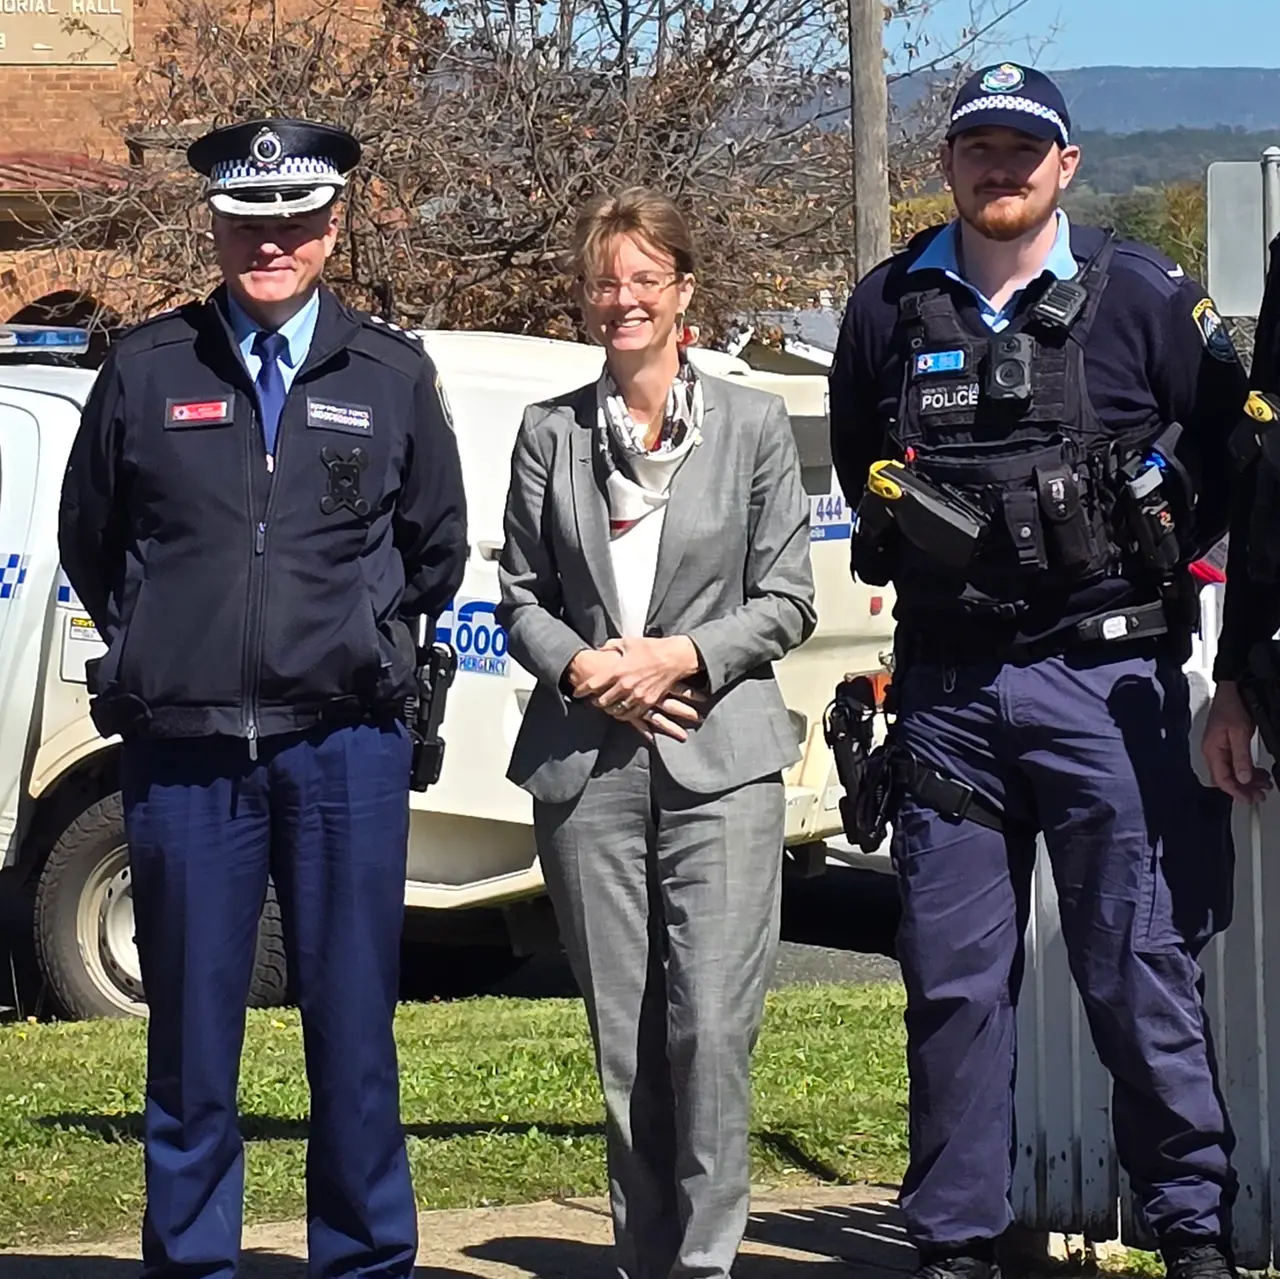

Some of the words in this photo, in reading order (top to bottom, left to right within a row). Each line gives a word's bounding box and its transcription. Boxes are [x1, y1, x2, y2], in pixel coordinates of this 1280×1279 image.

[922, 391, 978, 410] POLICE
[816, 496, 842, 522] 444
[456, 623, 508, 657] 000
